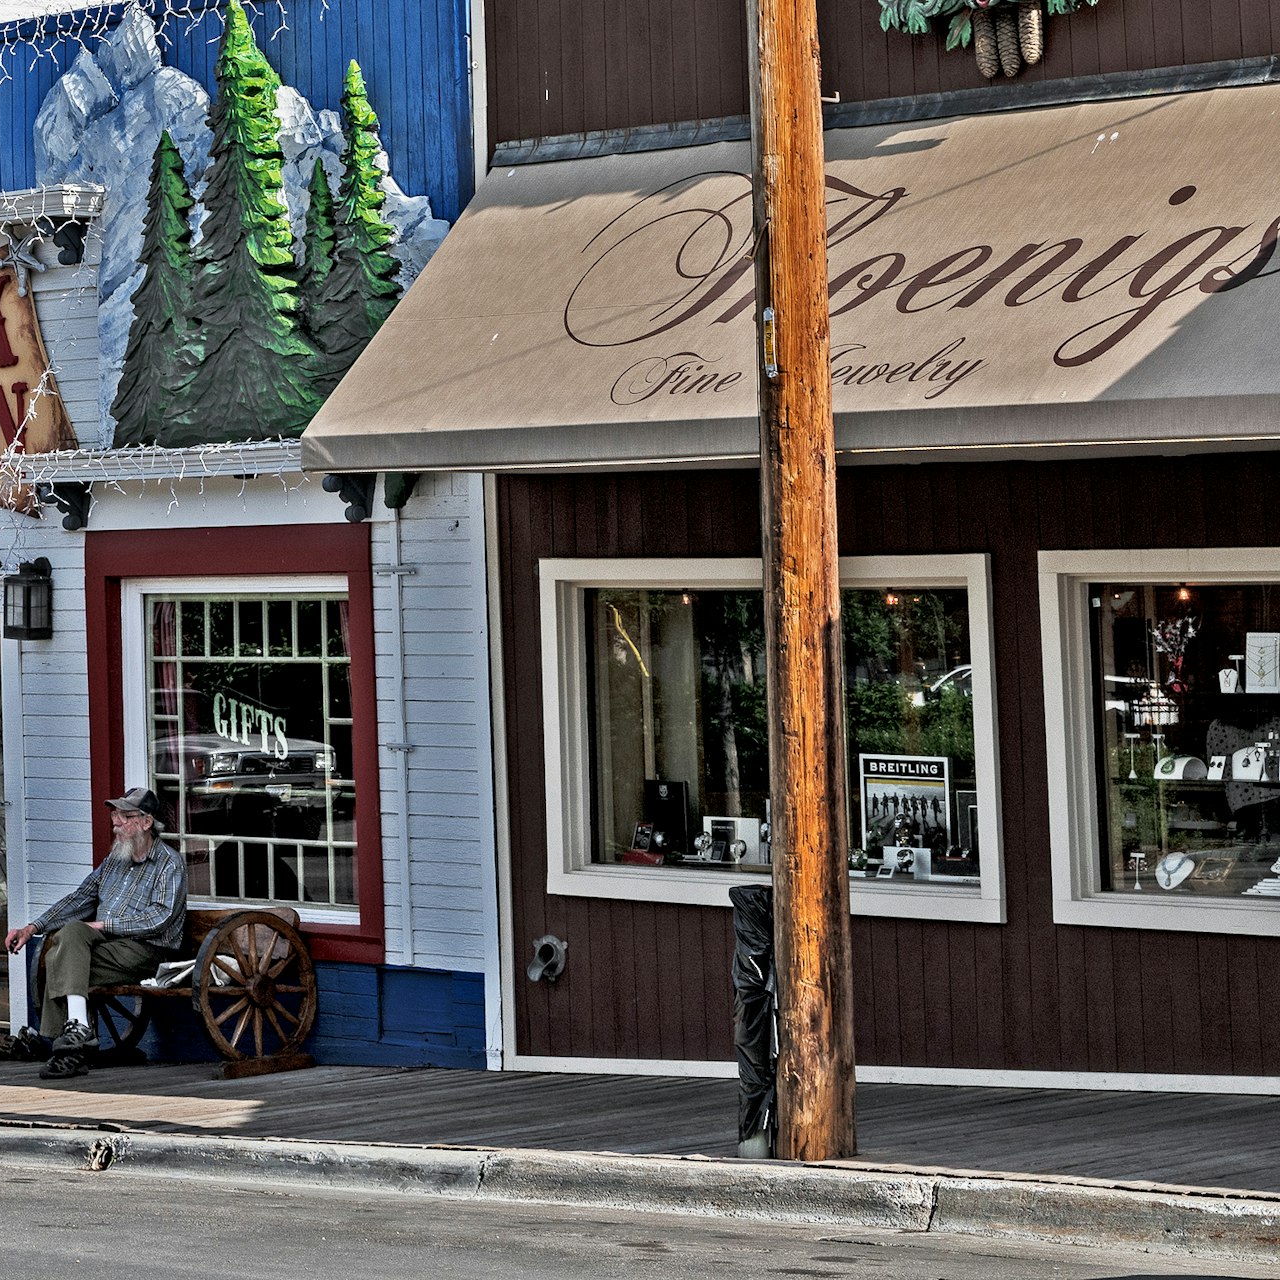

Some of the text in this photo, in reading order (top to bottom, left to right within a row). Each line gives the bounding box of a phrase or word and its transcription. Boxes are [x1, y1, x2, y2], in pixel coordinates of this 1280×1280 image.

[610, 337, 990, 405] Fine ewelry
[213, 692, 289, 761] GIFTS
[870, 762, 938, 774] BREITLING
